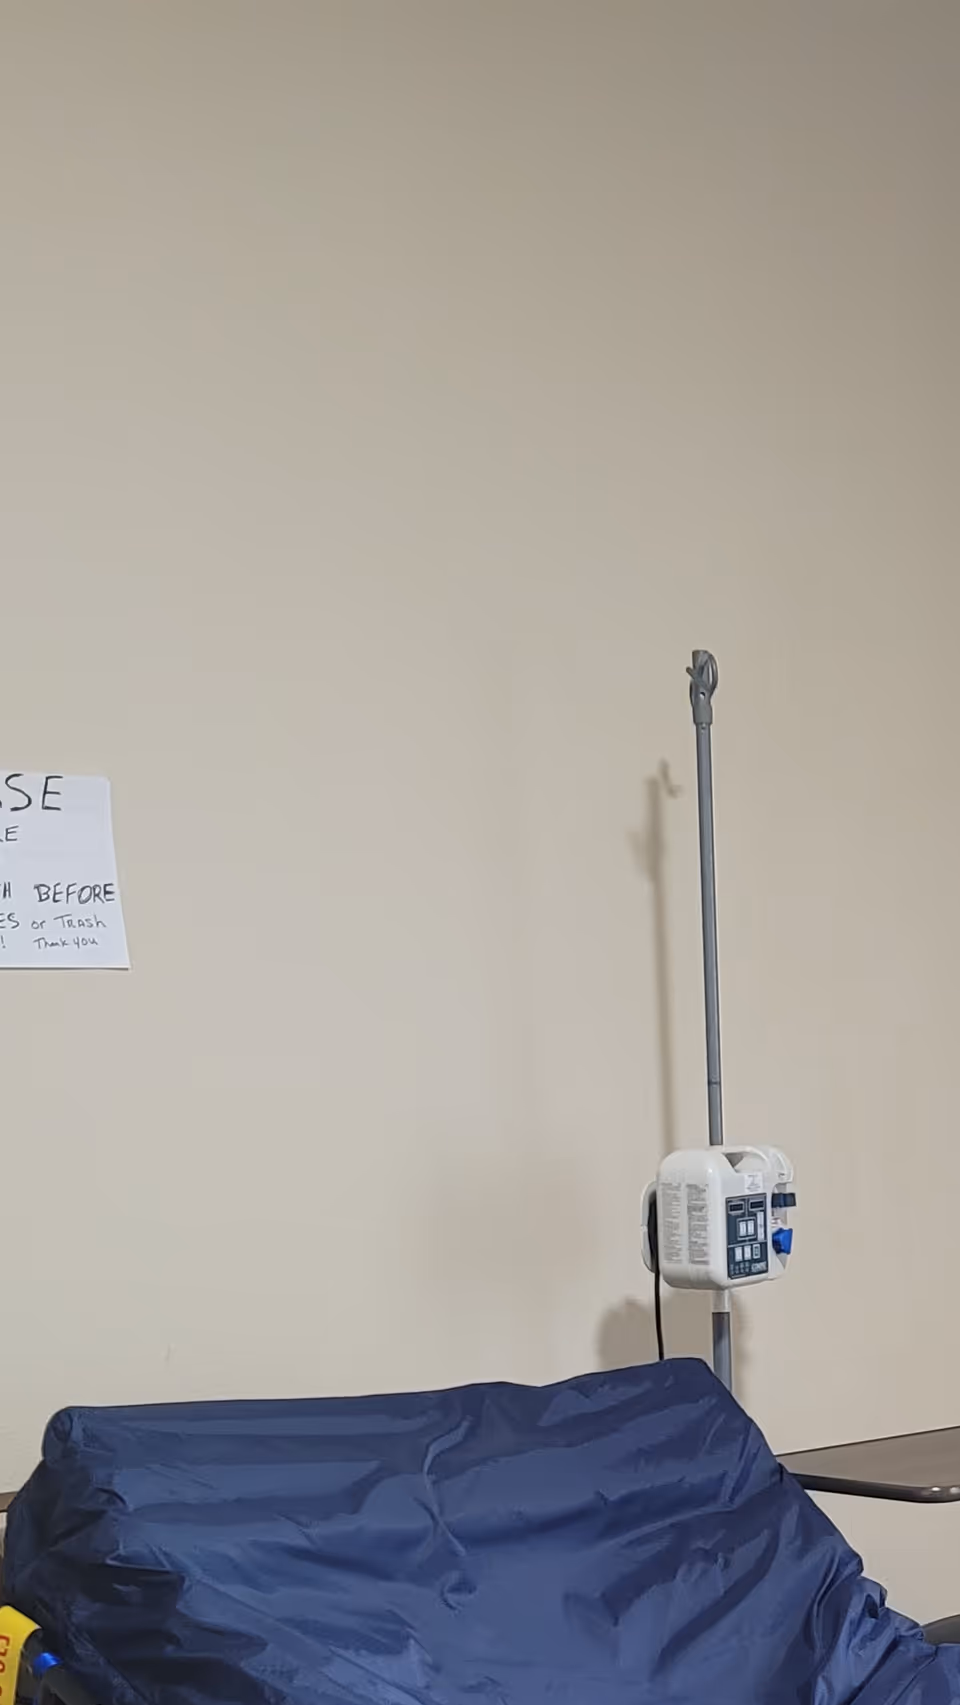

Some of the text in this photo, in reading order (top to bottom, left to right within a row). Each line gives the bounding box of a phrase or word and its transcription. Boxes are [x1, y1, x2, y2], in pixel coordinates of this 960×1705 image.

[0, 773, 63, 812] SE
[0, 825, 19, 842] E
[33, 882, 116, 905] BEFORE
